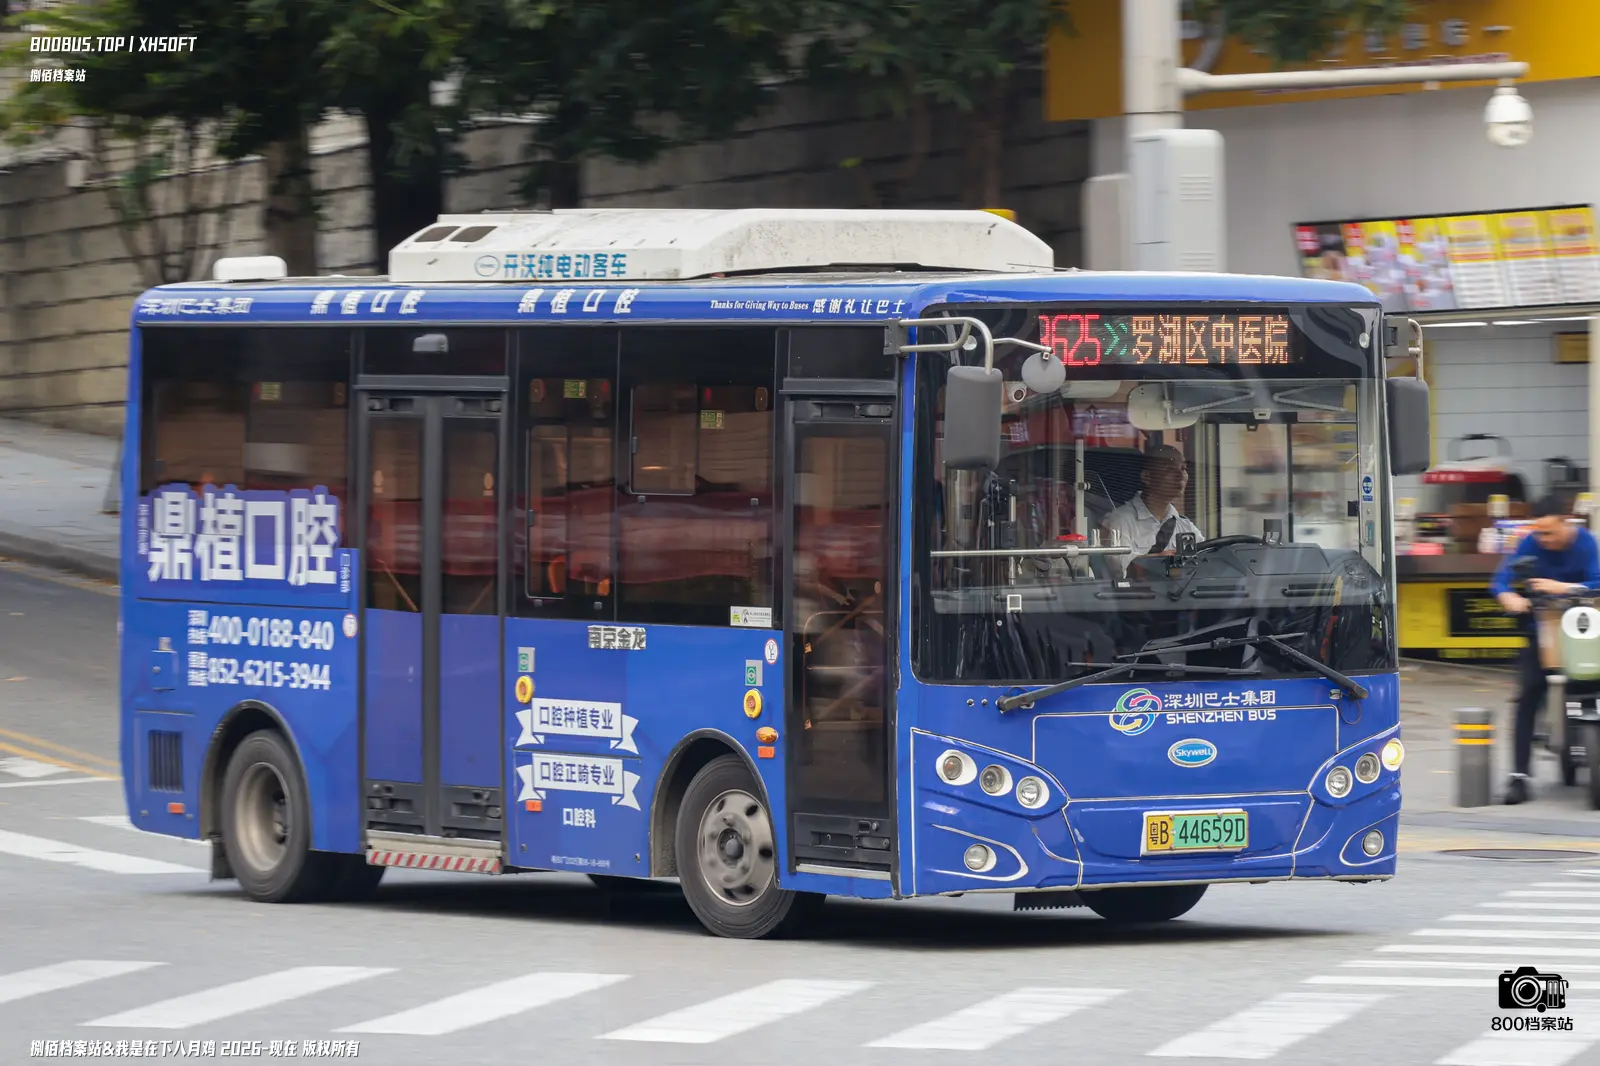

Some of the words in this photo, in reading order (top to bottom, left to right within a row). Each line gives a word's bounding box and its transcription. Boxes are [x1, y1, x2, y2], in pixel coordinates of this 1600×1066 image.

[503, 253, 627, 278] 开沃纯电动客车
[710, 299, 733, 309] Thanks
[733, 300, 744, 310] for
[744, 300, 766, 311] Giving
[767, 300, 781, 311] Way
[781, 301, 788, 310] to
[789, 300, 809, 310] Buses
[812, 298, 906, 315] 感谢礼让巴士
[1132, 314, 1289, 364] 罗湖区中医院
[147, 491, 338, 586] 鼎植口腔
[208, 615, 335, 651] 400-0188-840
[589, 626, 646, 650] 南京金龙
[207, 657, 332, 691] 852-6215-3944
[1164, 689, 1276, 709] 深圳巴士集团
[539, 705, 614, 730] 口腔种植专业
[1166, 710, 1244, 725] SHENZHEN
[1248, 709, 1277, 721] BUS
[1175, 747, 1212, 758] Skywell
[540, 761, 615, 786] 口腔正畸专业
[563, 807, 596, 829] 口腔科
